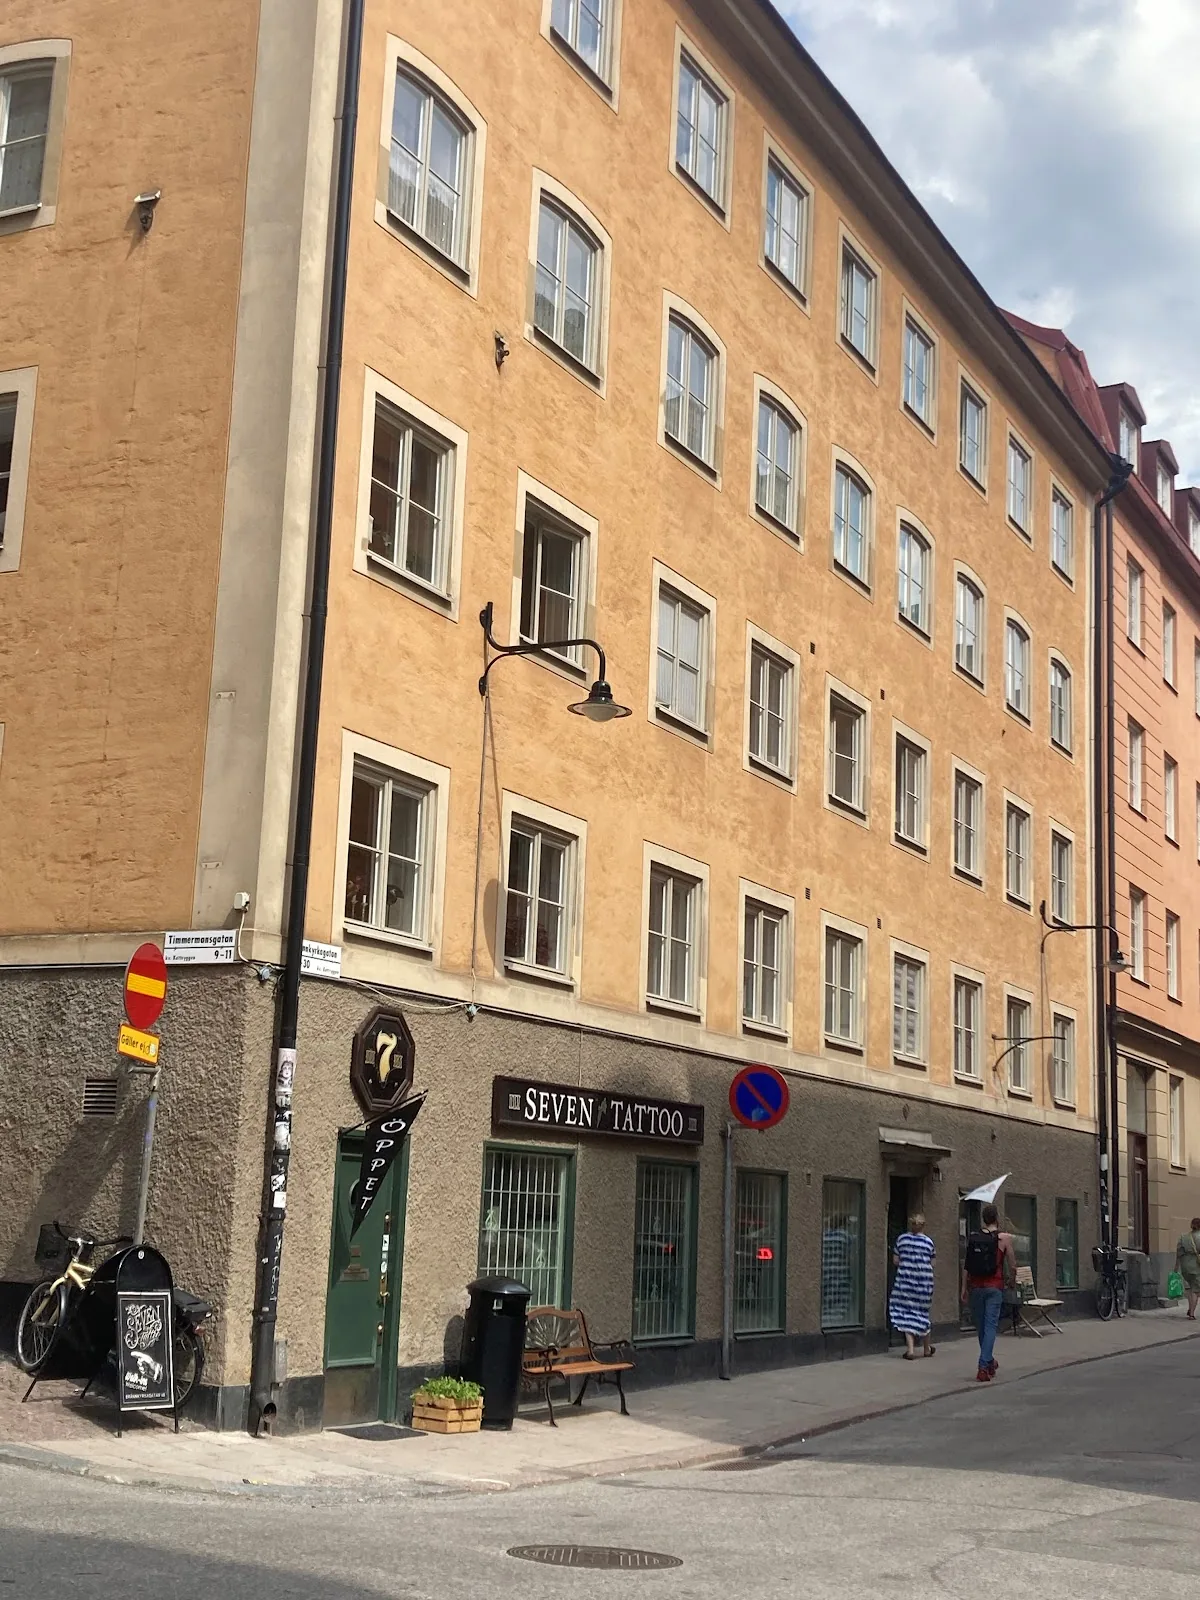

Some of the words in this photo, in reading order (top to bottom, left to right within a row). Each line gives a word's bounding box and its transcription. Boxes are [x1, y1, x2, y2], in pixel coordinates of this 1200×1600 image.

[168, 935, 233, 946] Timmermansgatan
[214, 949, 233, 960] 9-11
[121, 1034, 139, 1048] Gäller
[376, 1030, 398, 1083] 7
[524, 1087, 594, 1127] SEVEN
[610, 1100, 683, 1137] TATTOO
[360, 1118, 406, 1210] ÖPPET
[125, 1304, 162, 1349] SEVEN
